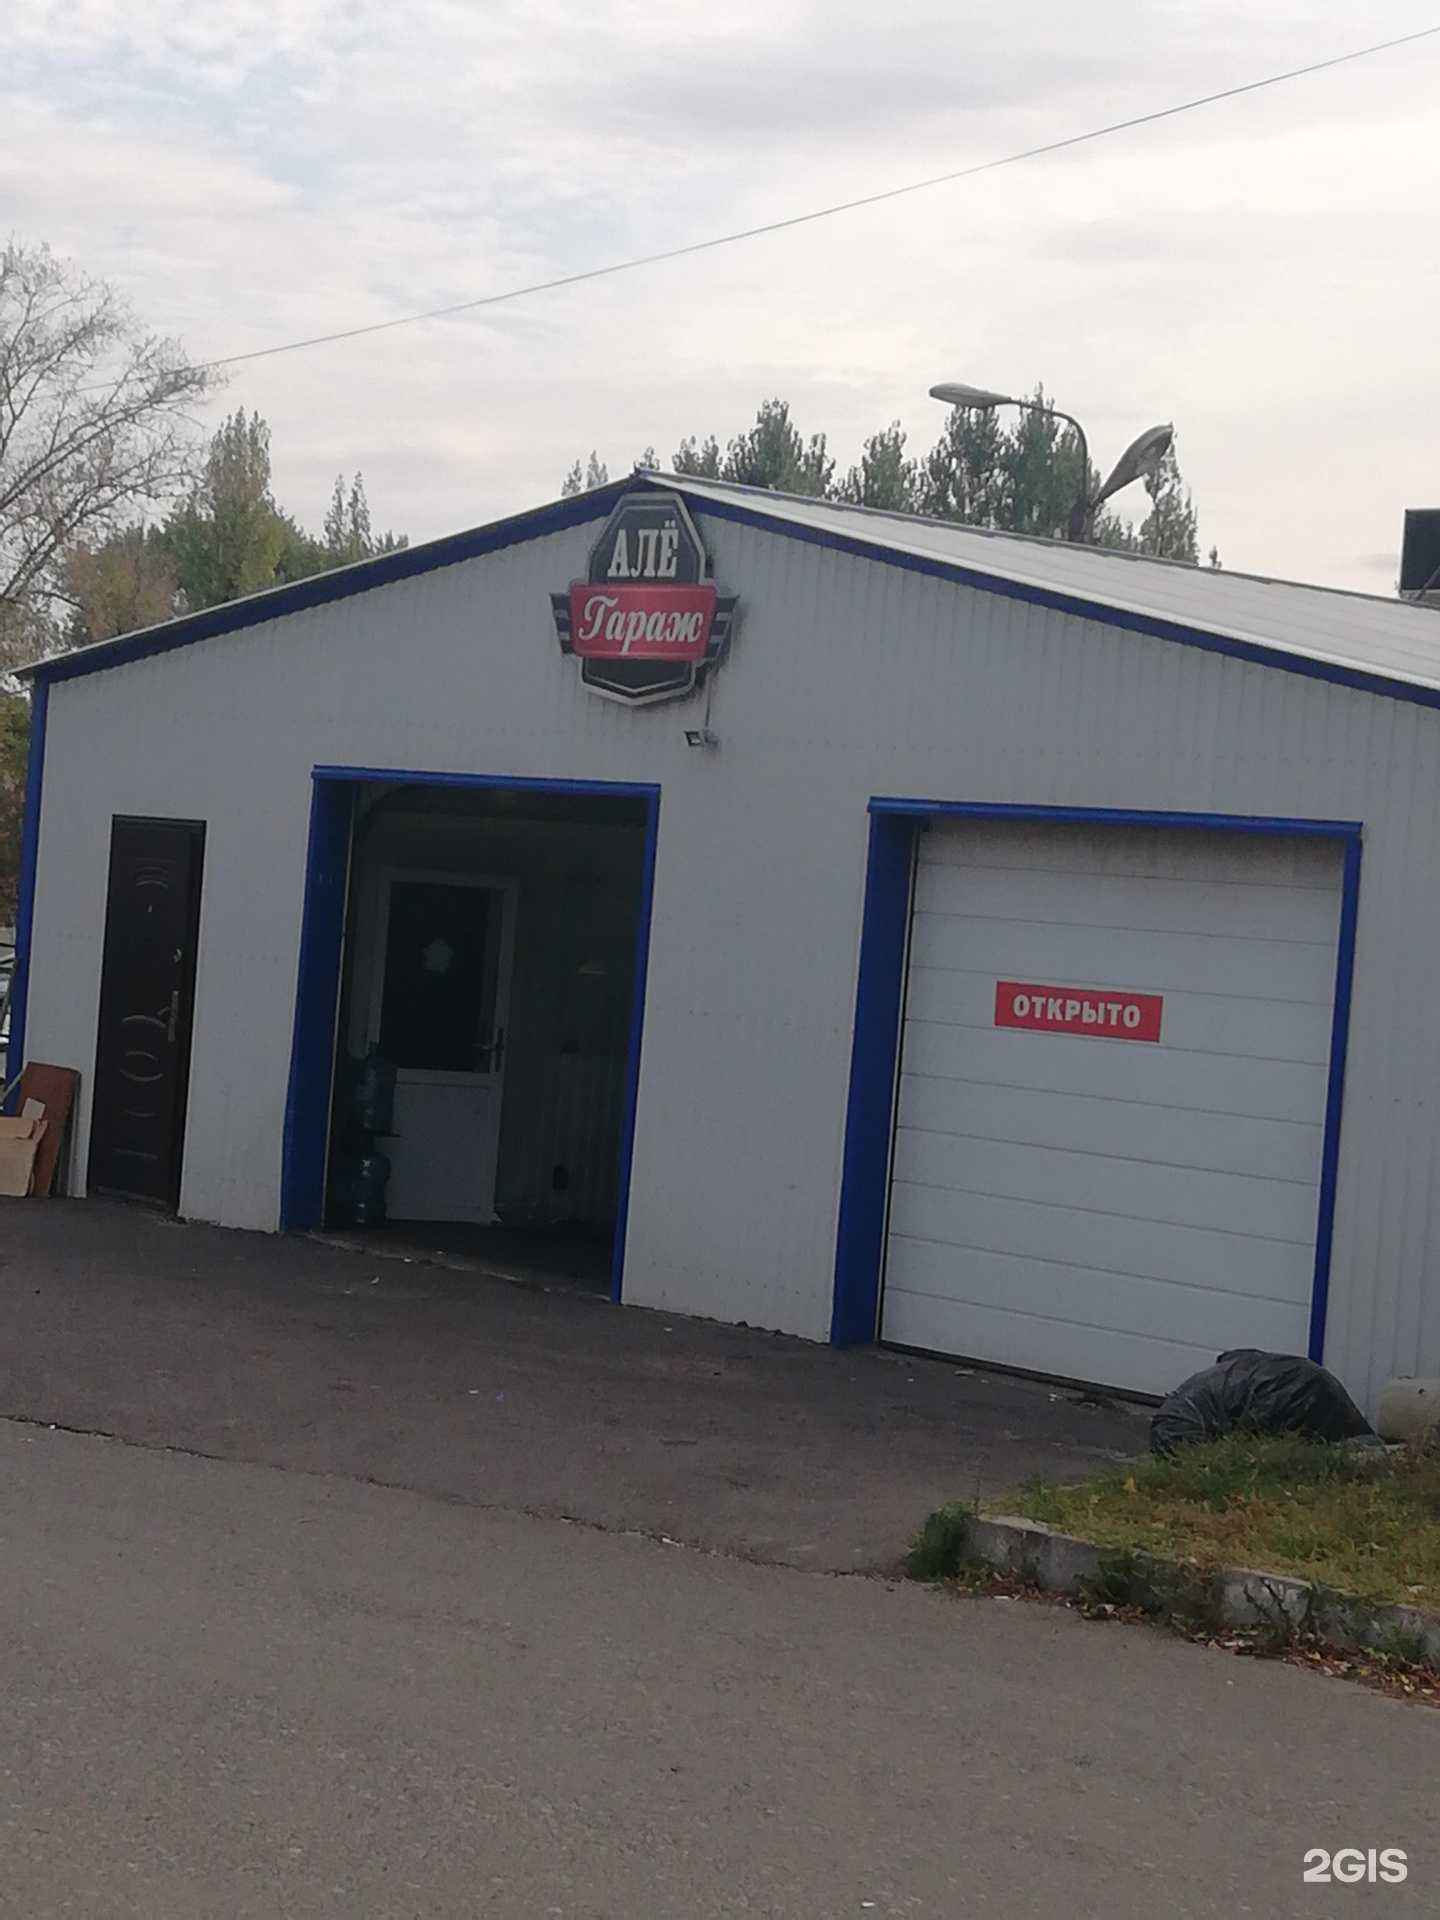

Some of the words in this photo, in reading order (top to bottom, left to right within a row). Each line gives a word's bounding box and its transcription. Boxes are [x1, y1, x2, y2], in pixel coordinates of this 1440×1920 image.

[607, 520, 679, 578] АЛЁ
[578, 595, 704, 656] Гараж
[1013, 994, 1141, 1028] ОТКРЫТО
